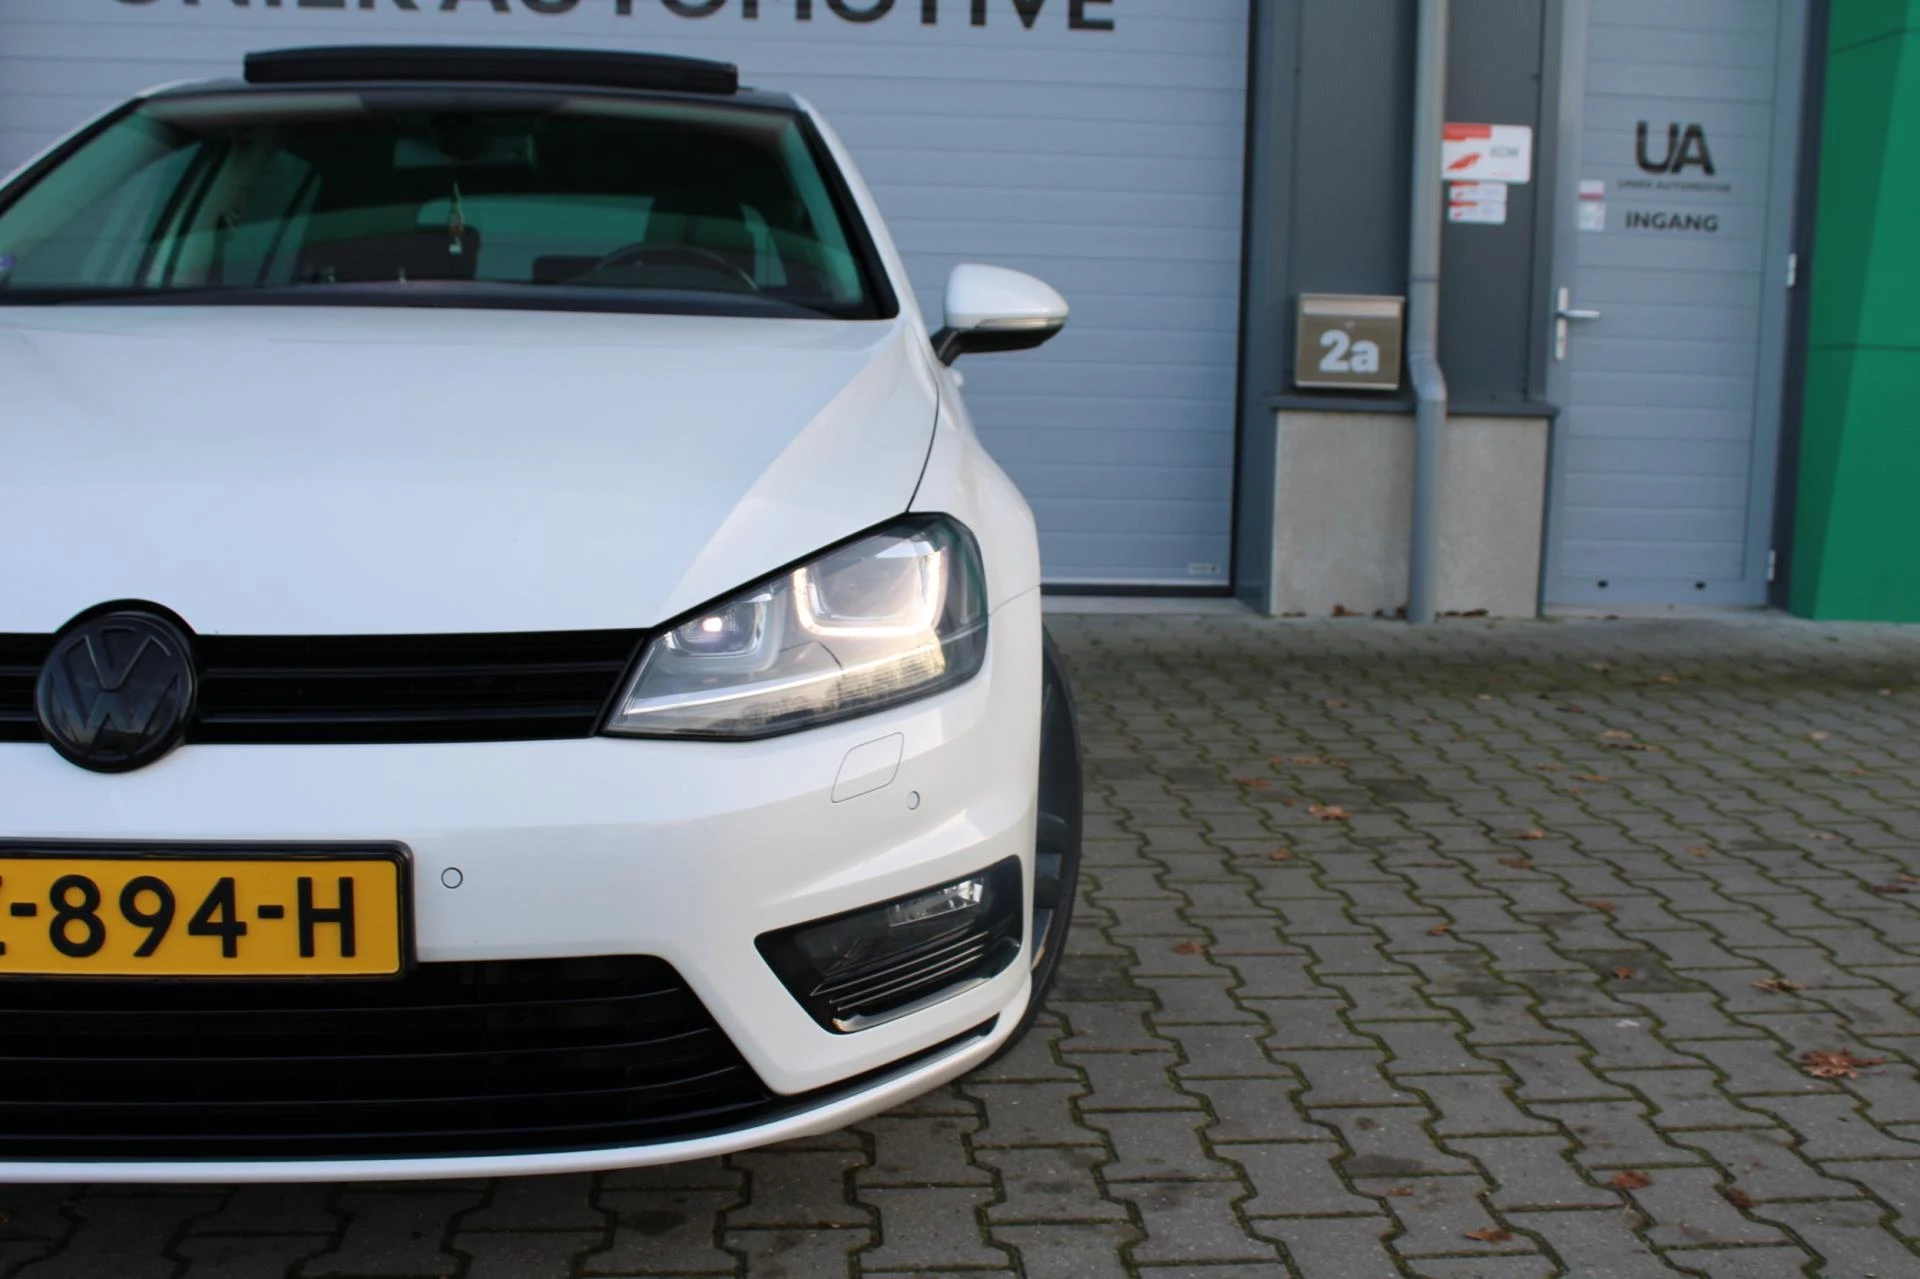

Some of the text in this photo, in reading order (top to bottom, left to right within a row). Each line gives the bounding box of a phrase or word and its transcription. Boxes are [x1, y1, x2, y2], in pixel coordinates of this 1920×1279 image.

[1636, 121, 1715, 175] UA
[1626, 211, 1718, 232] INGANG
[1320, 329, 1379, 373] 2a
[0, 874, 356, 958] -894-H
